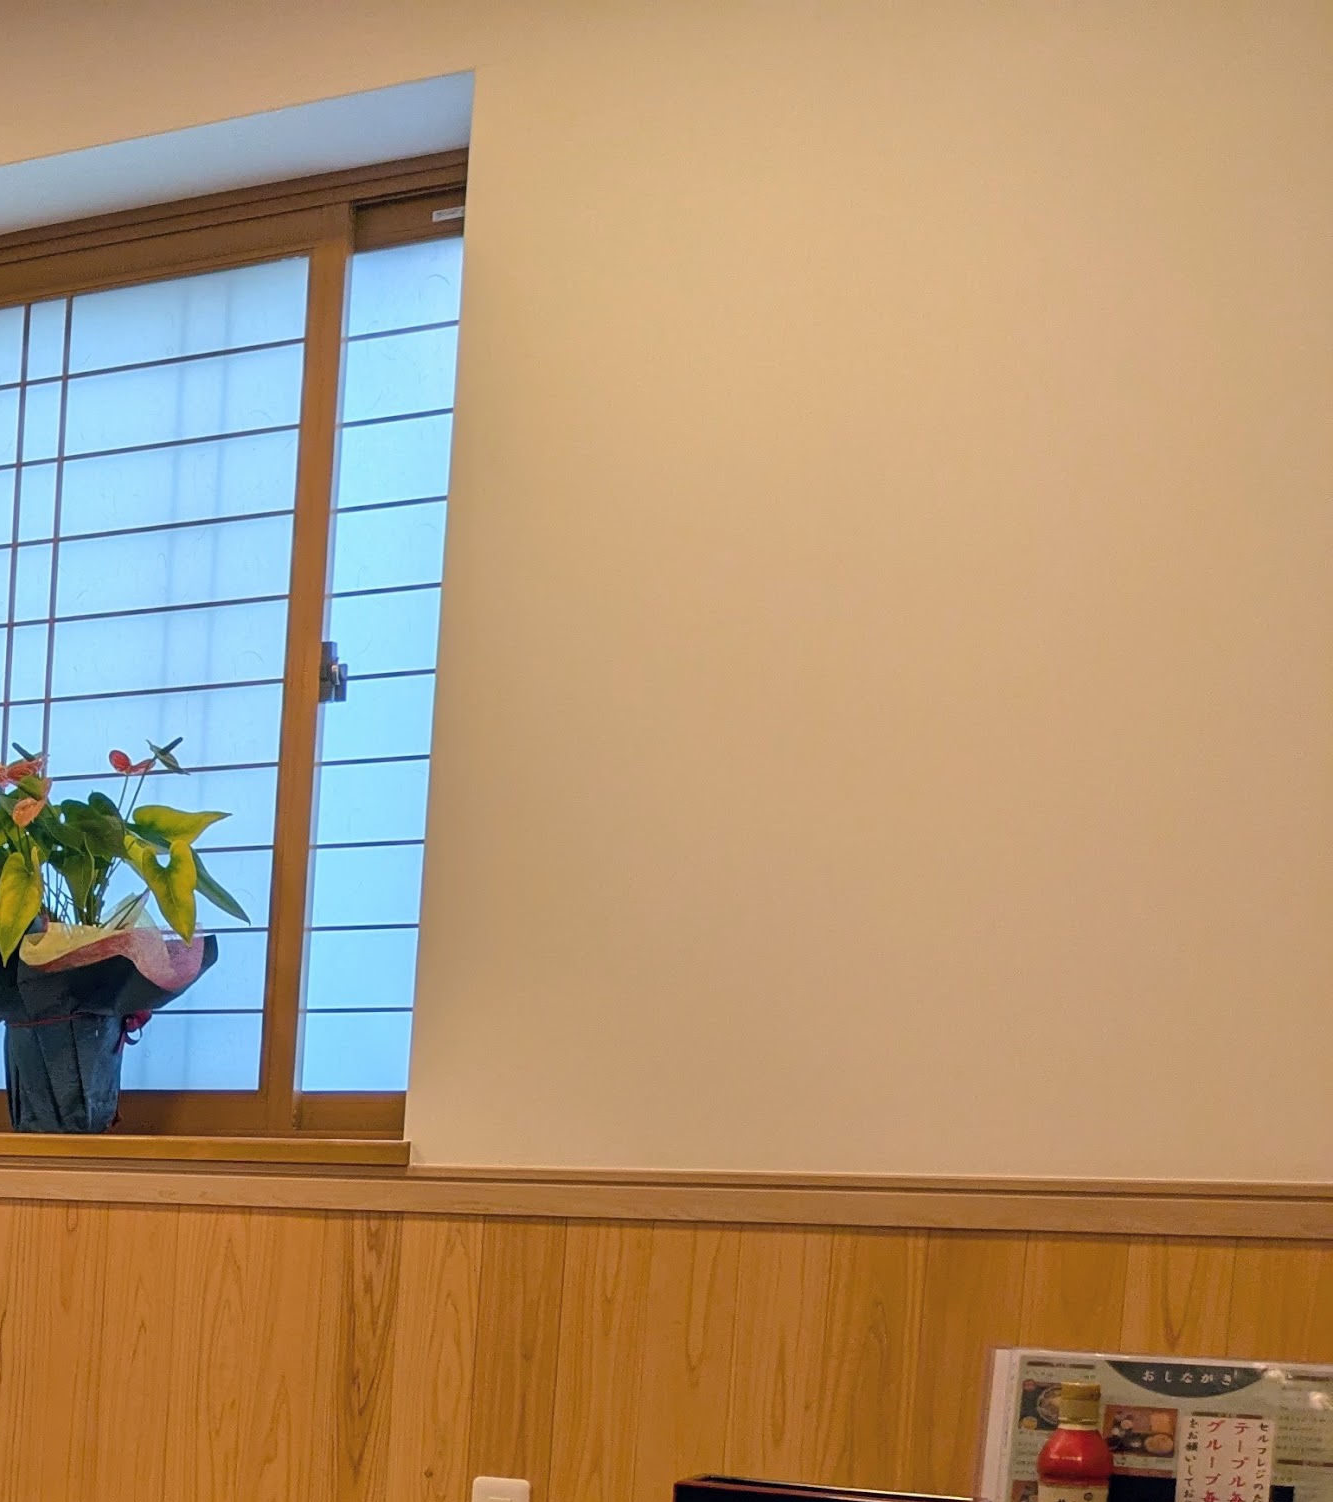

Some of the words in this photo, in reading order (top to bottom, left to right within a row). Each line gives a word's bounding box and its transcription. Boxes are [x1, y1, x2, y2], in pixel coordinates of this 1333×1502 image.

[1141, 1369, 1238, 1386] おしながき
